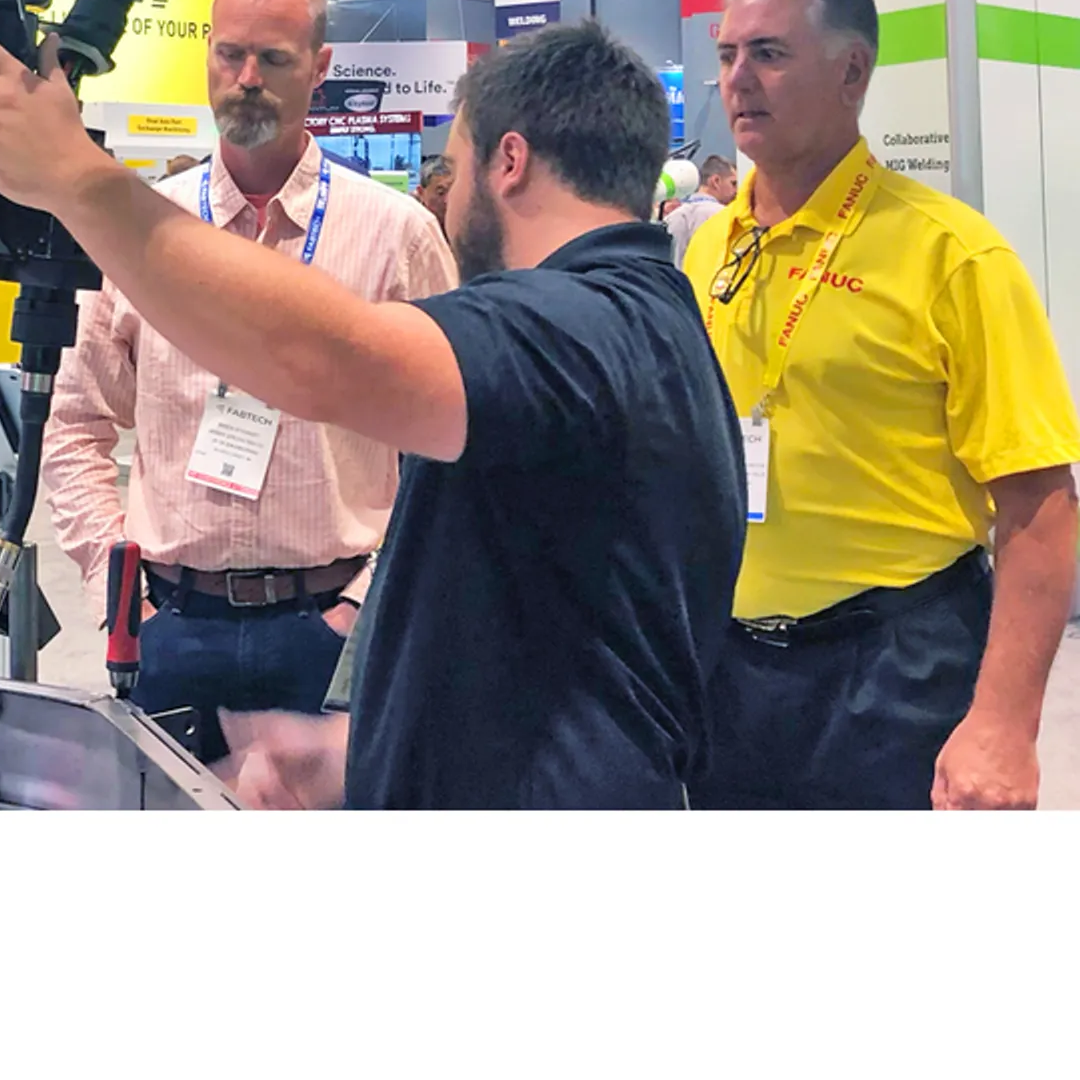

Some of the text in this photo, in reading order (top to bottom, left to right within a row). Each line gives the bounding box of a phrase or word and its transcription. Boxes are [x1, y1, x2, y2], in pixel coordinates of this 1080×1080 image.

[132, 18, 152, 35] OF
[157, 20, 197, 39] YOUR
[333, 64, 397, 78] Science.
[395, 84, 411, 95] to
[414, 81, 447, 94] Life.
[883, 133, 950, 147] Collaborative
[906, 158, 950, 174] Welding
[836, 173, 869, 220] FANUC
[778, 294, 809, 348] FANUC
